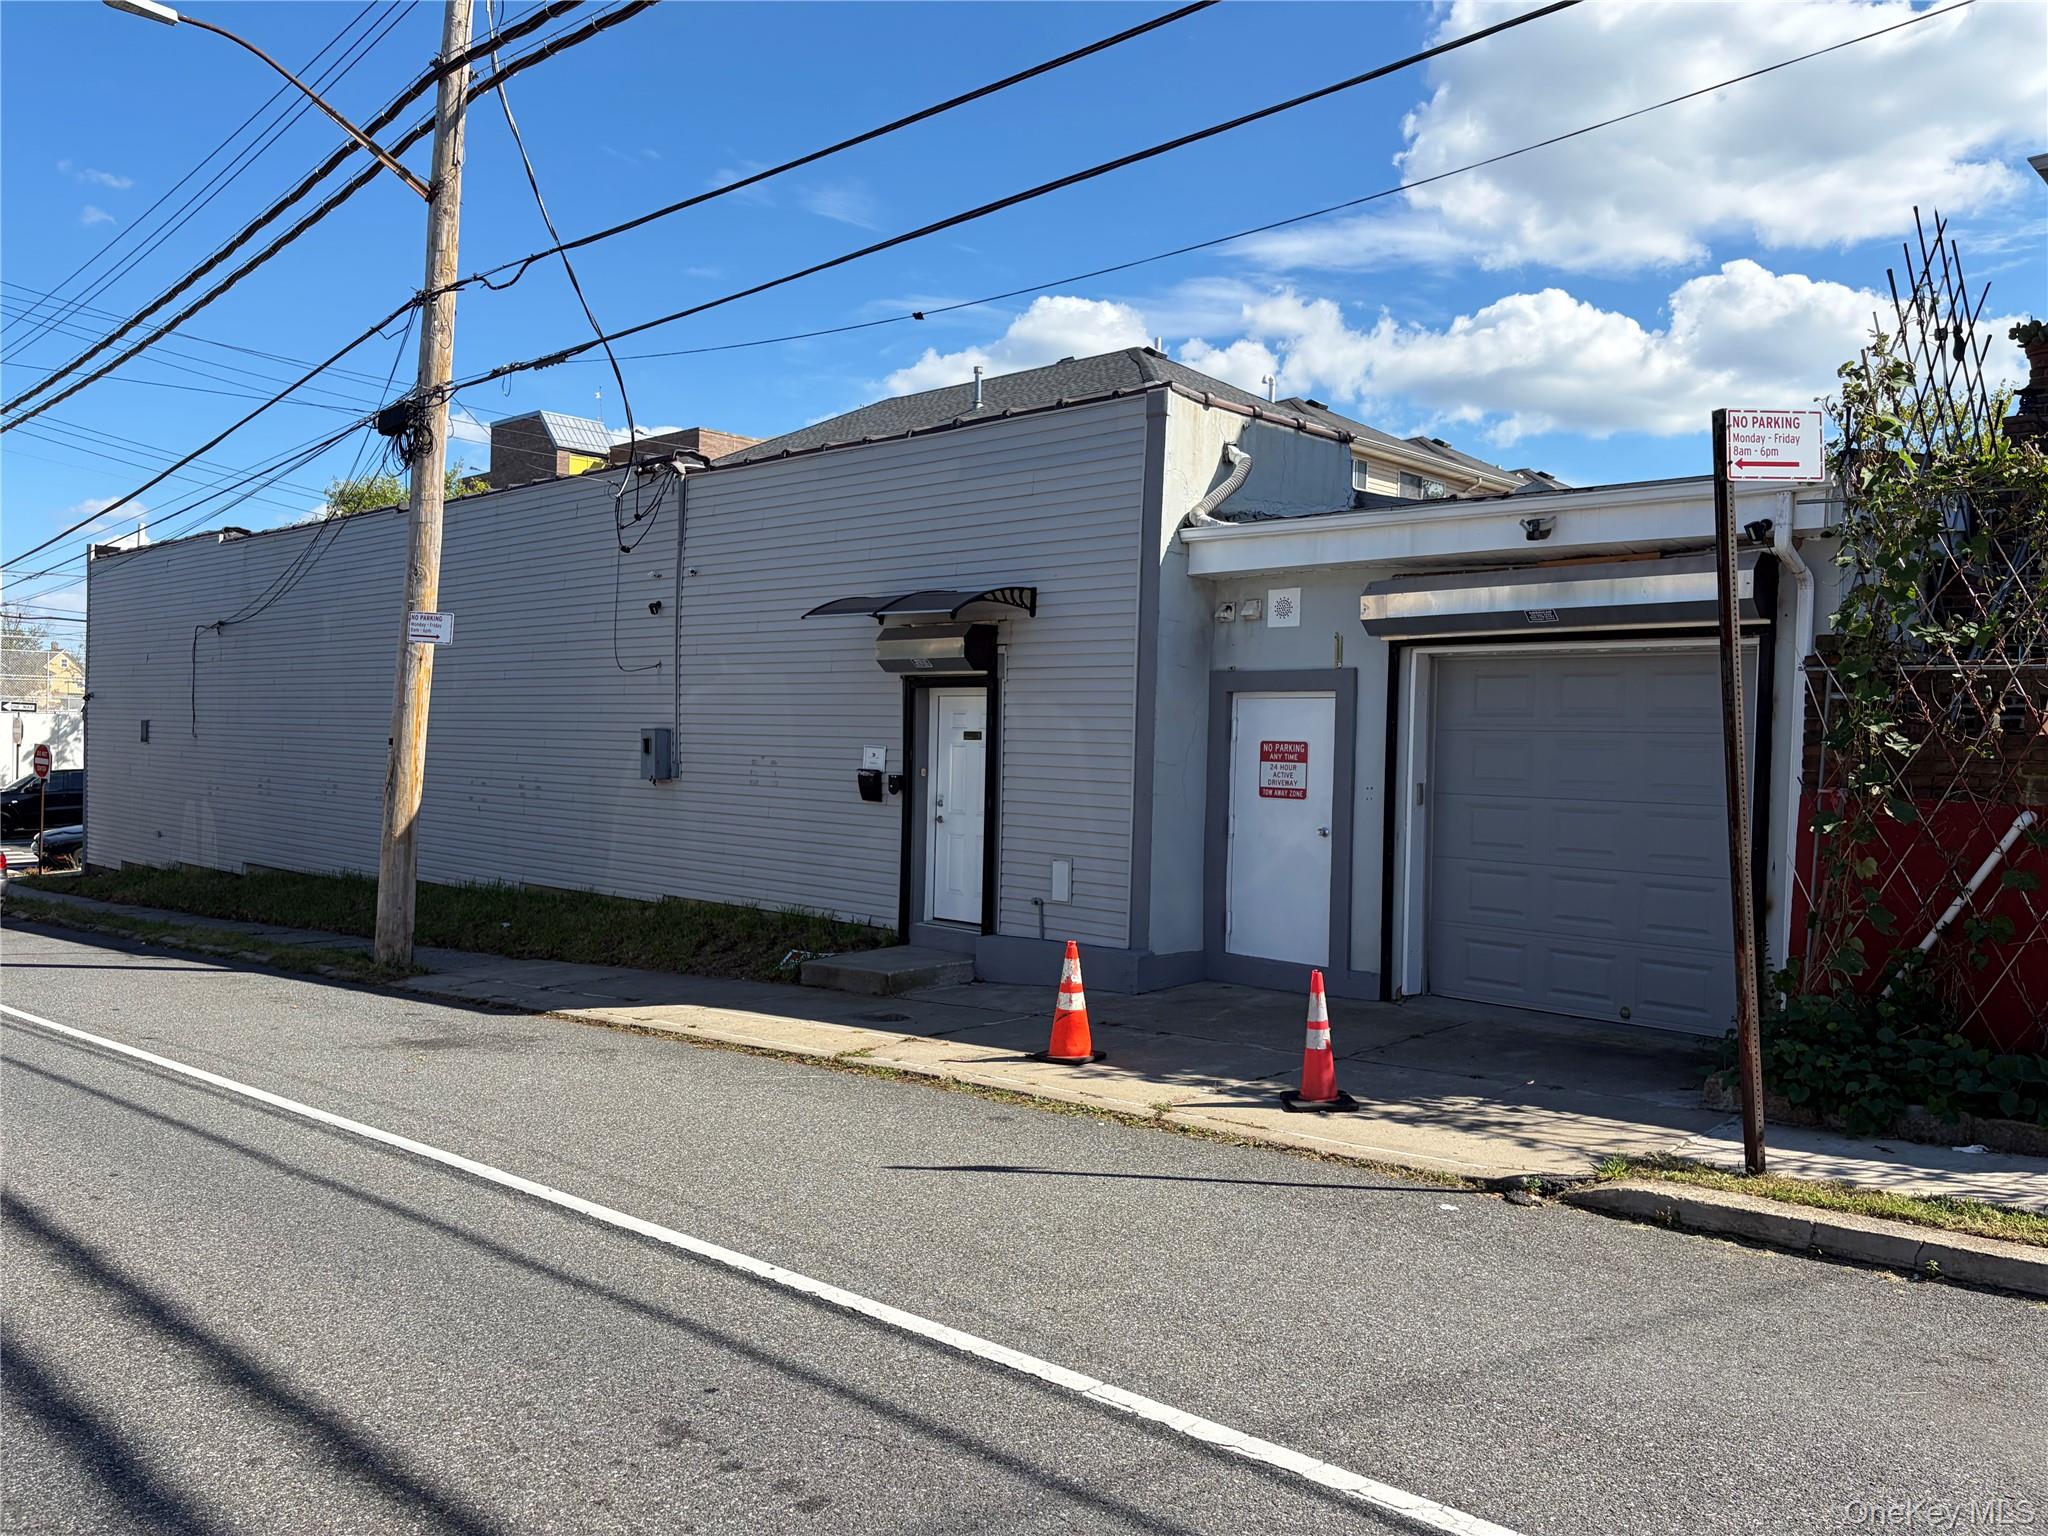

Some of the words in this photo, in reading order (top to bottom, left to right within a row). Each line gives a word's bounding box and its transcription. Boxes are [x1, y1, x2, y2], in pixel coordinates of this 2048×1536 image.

[1732, 416, 1748, 428] NO
[1752, 416, 1800, 429] PARKING
[1733, 433, 1765, 445] Monday
[1774, 433, 1800, 446] Friday
[1733, 446, 1752, 456] 8am
[1760, 447, 1779, 458] 6pm
[1263, 743, 1273, 751] NO
[1275, 743, 1305, 753] PARKING
[1273, 771, 1294, 779] ACTIVE
[1263, 788, 1273, 796] TOW
